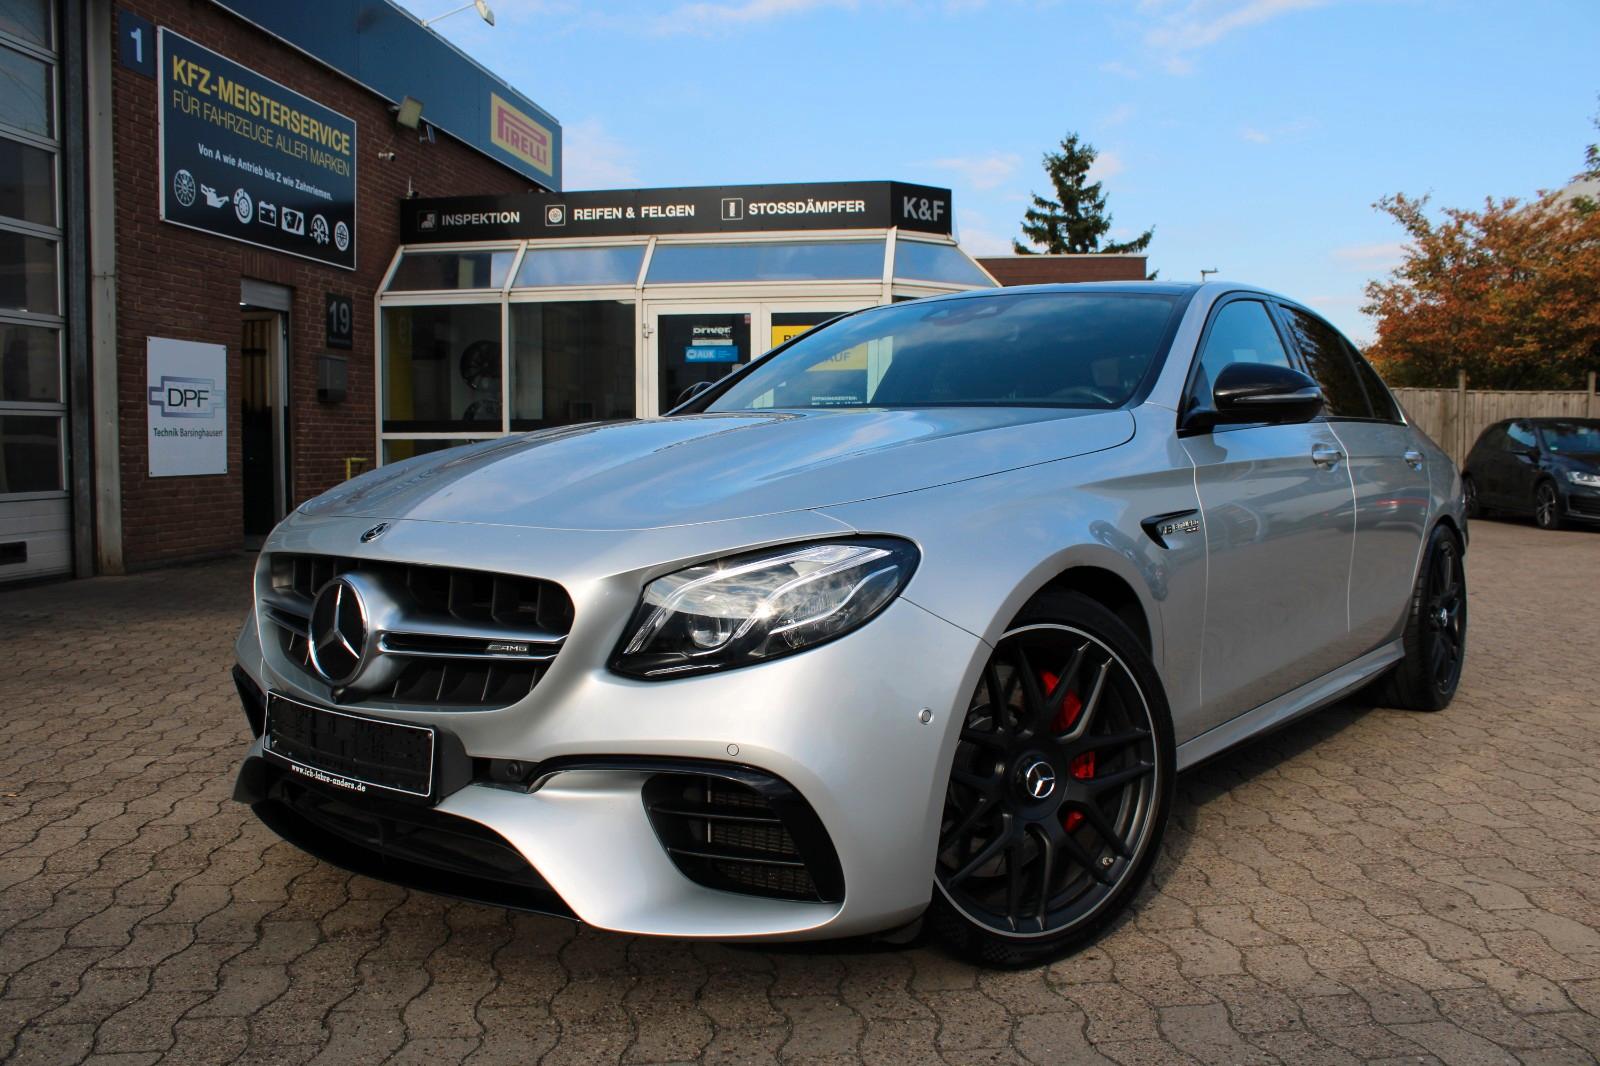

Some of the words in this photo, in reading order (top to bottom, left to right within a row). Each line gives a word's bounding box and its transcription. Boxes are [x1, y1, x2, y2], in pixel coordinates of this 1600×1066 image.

[130, 27, 143, 64] 1
[172, 54, 350, 156] KFZ-MEISTERSERVICE
[173, 89, 201, 119] FÜR
[203, 103, 274, 148] FAHRZEUGE
[275, 133, 308, 161] ALLER
[310, 147, 350, 178] MARKEN
[497, 105, 547, 167] PIRELLI
[198, 142, 214, 160] Von
[215, 149, 221, 161] A
[223, 154, 236, 167] wie
[238, 158, 263, 177] Antrieb
[264, 167, 275, 181] bis
[276, 171, 282, 183] Z
[282, 175, 295, 188] wie
[441, 211, 520, 226] INSPEKTION
[573, 206, 622, 221] REIFEN
[625, 206, 636, 219] &
[640, 204, 695, 218] FELGEN
[748, 198, 866, 216] STOSSDÄMPFER
[902, 196, 945, 223] K&F
[329, 300, 350, 335] 19
[167, 388, 210, 408] DPF
[153, 427, 179, 438] Technik
[179, 428, 223, 440] Barsinghausen
